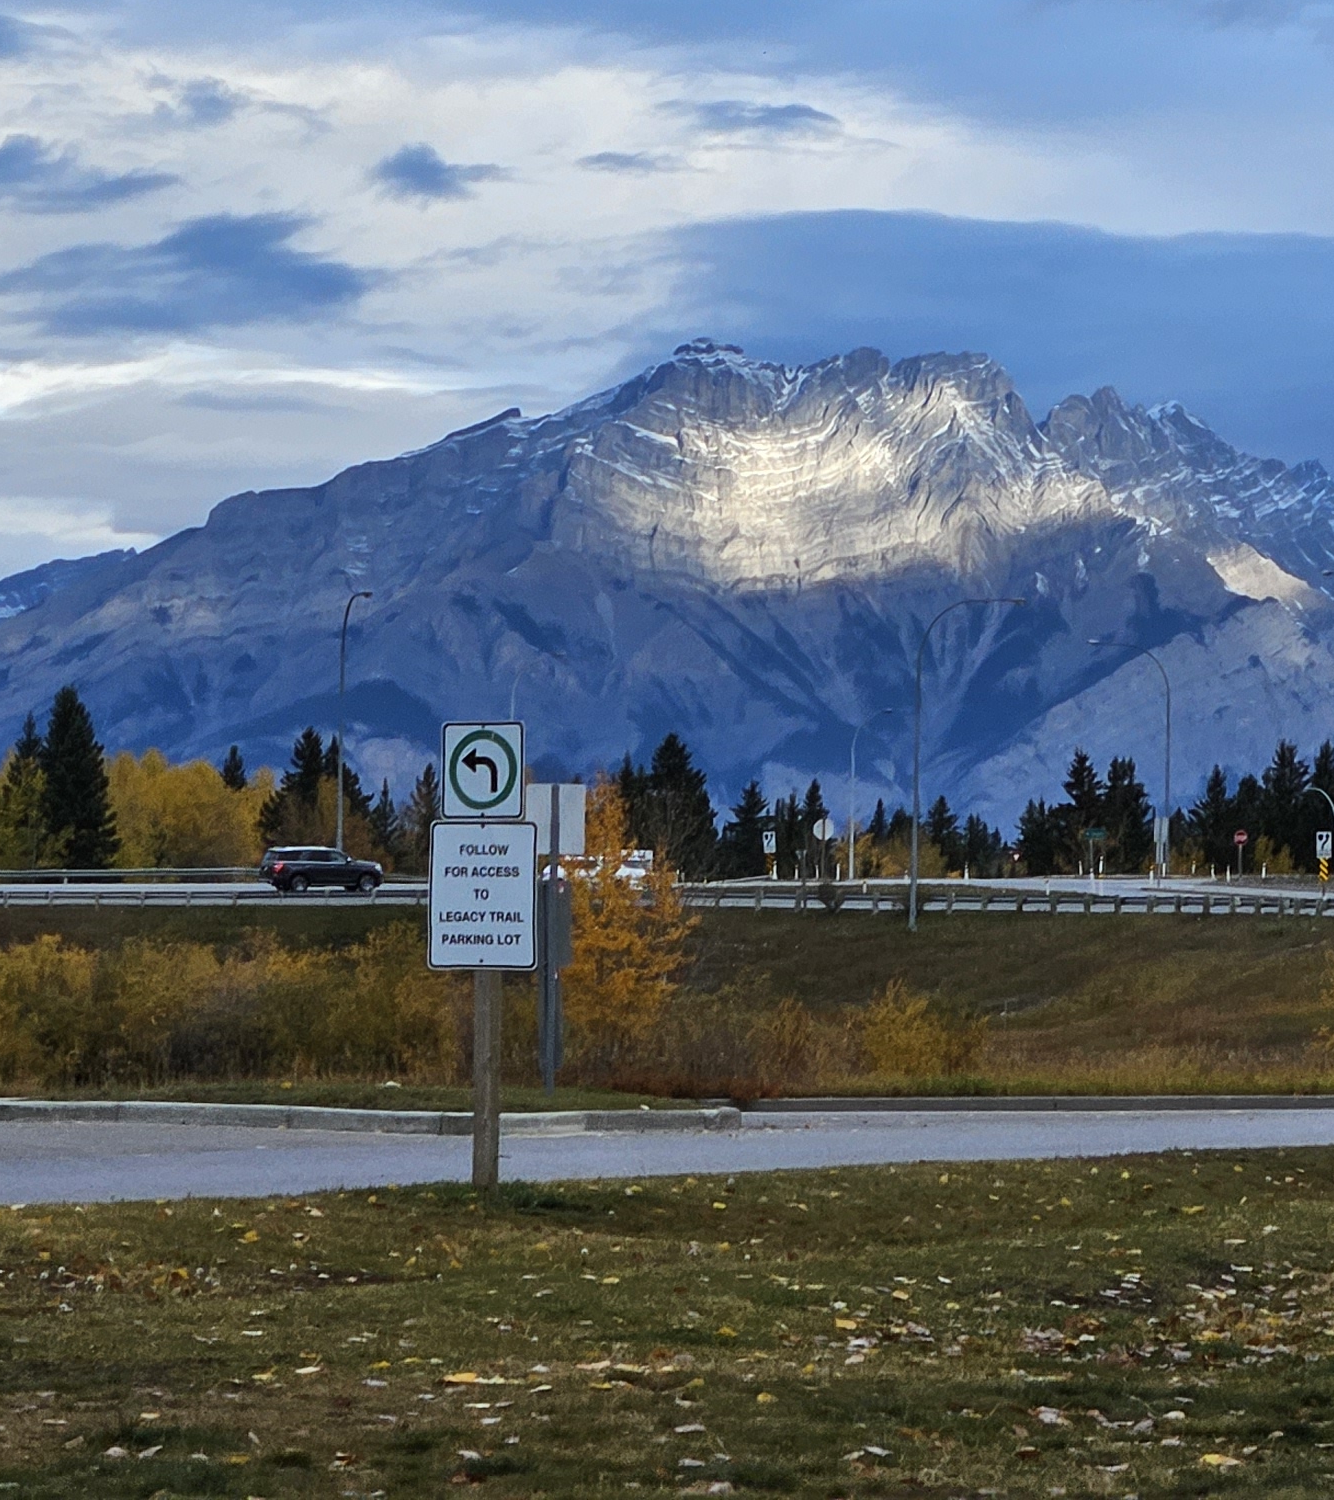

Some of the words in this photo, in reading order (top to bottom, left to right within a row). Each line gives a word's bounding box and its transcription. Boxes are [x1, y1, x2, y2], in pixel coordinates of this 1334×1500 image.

[459, 844, 509, 856] FOLLOW
[444, 866, 468, 878] FOR
[471, 866, 520, 878] ACCESS
[473, 888, 489, 900] TO
[439, 911, 486, 923] LEGACY
[490, 911, 524, 923] TRAIL
[441, 934, 494, 945] PARKING
[497, 934, 522, 945] LOT
